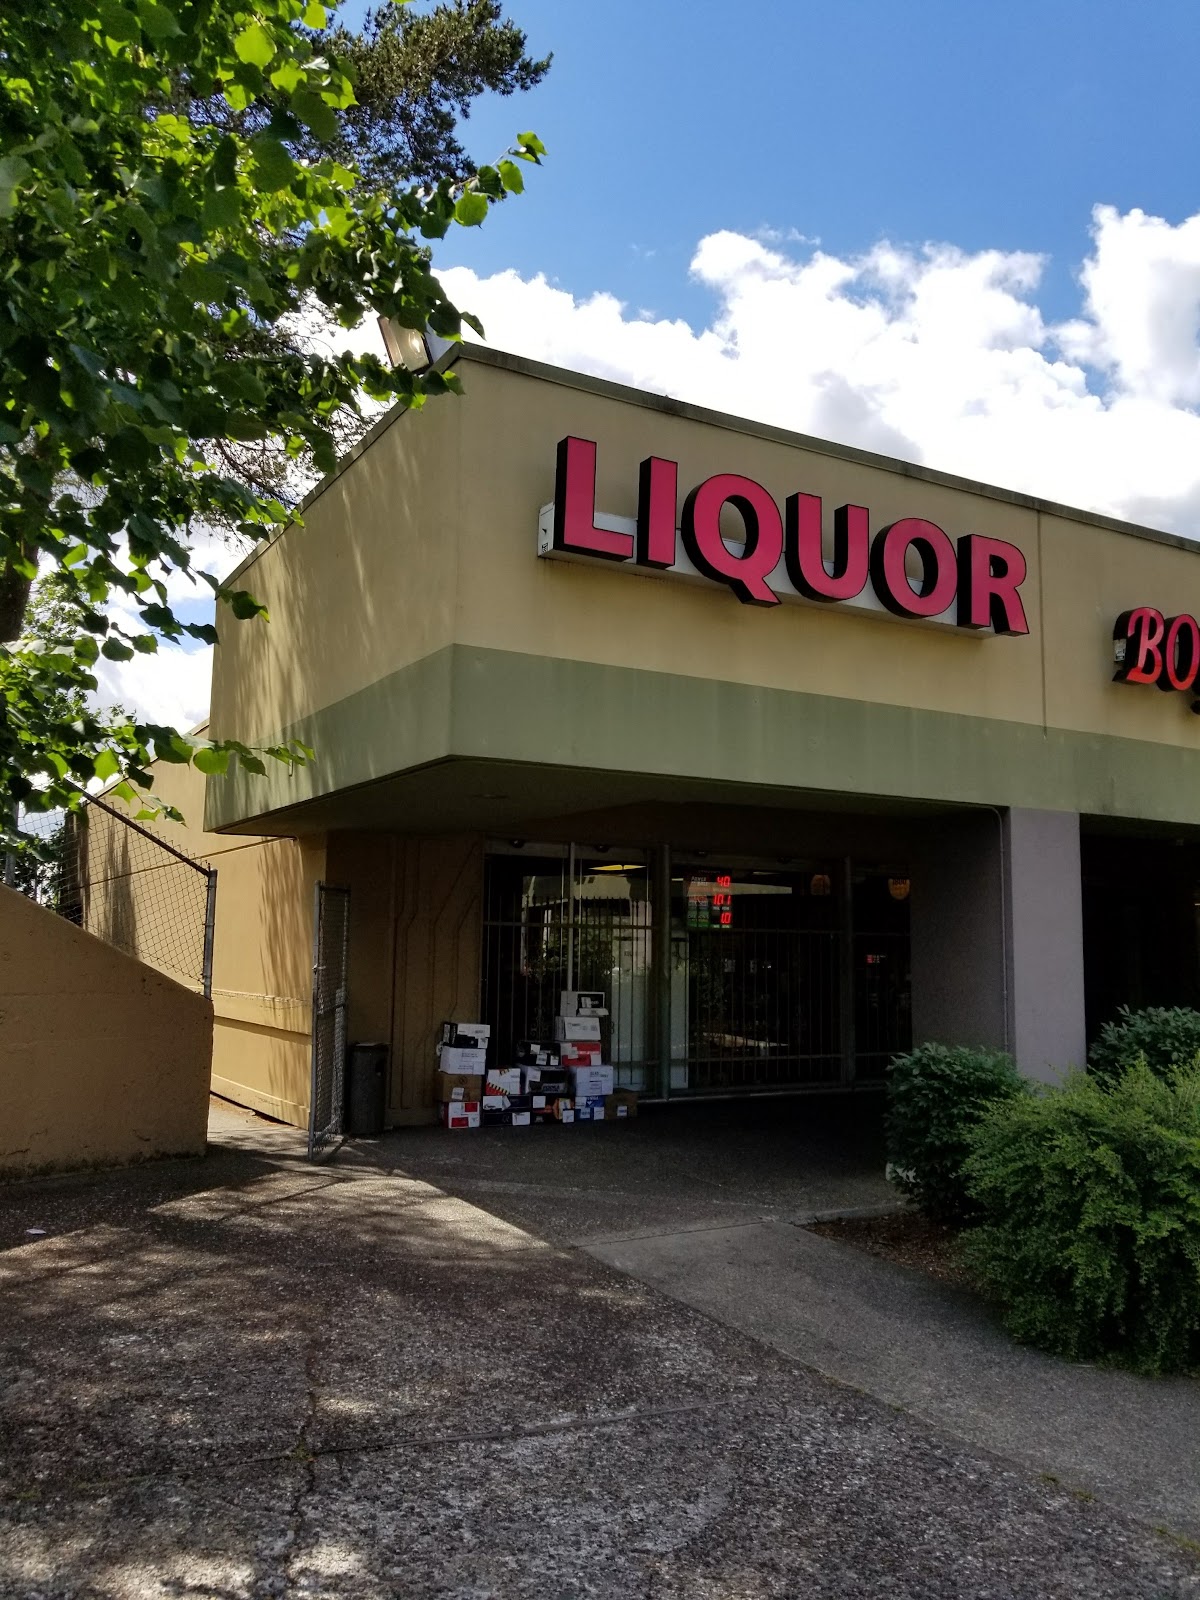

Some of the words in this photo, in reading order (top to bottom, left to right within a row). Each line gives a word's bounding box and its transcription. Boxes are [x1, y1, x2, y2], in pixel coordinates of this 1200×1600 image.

[556, 435, 1030, 636] LIQUOR
[1116, 606, 1200, 684] BO
[716, 875, 731, 888] 40
